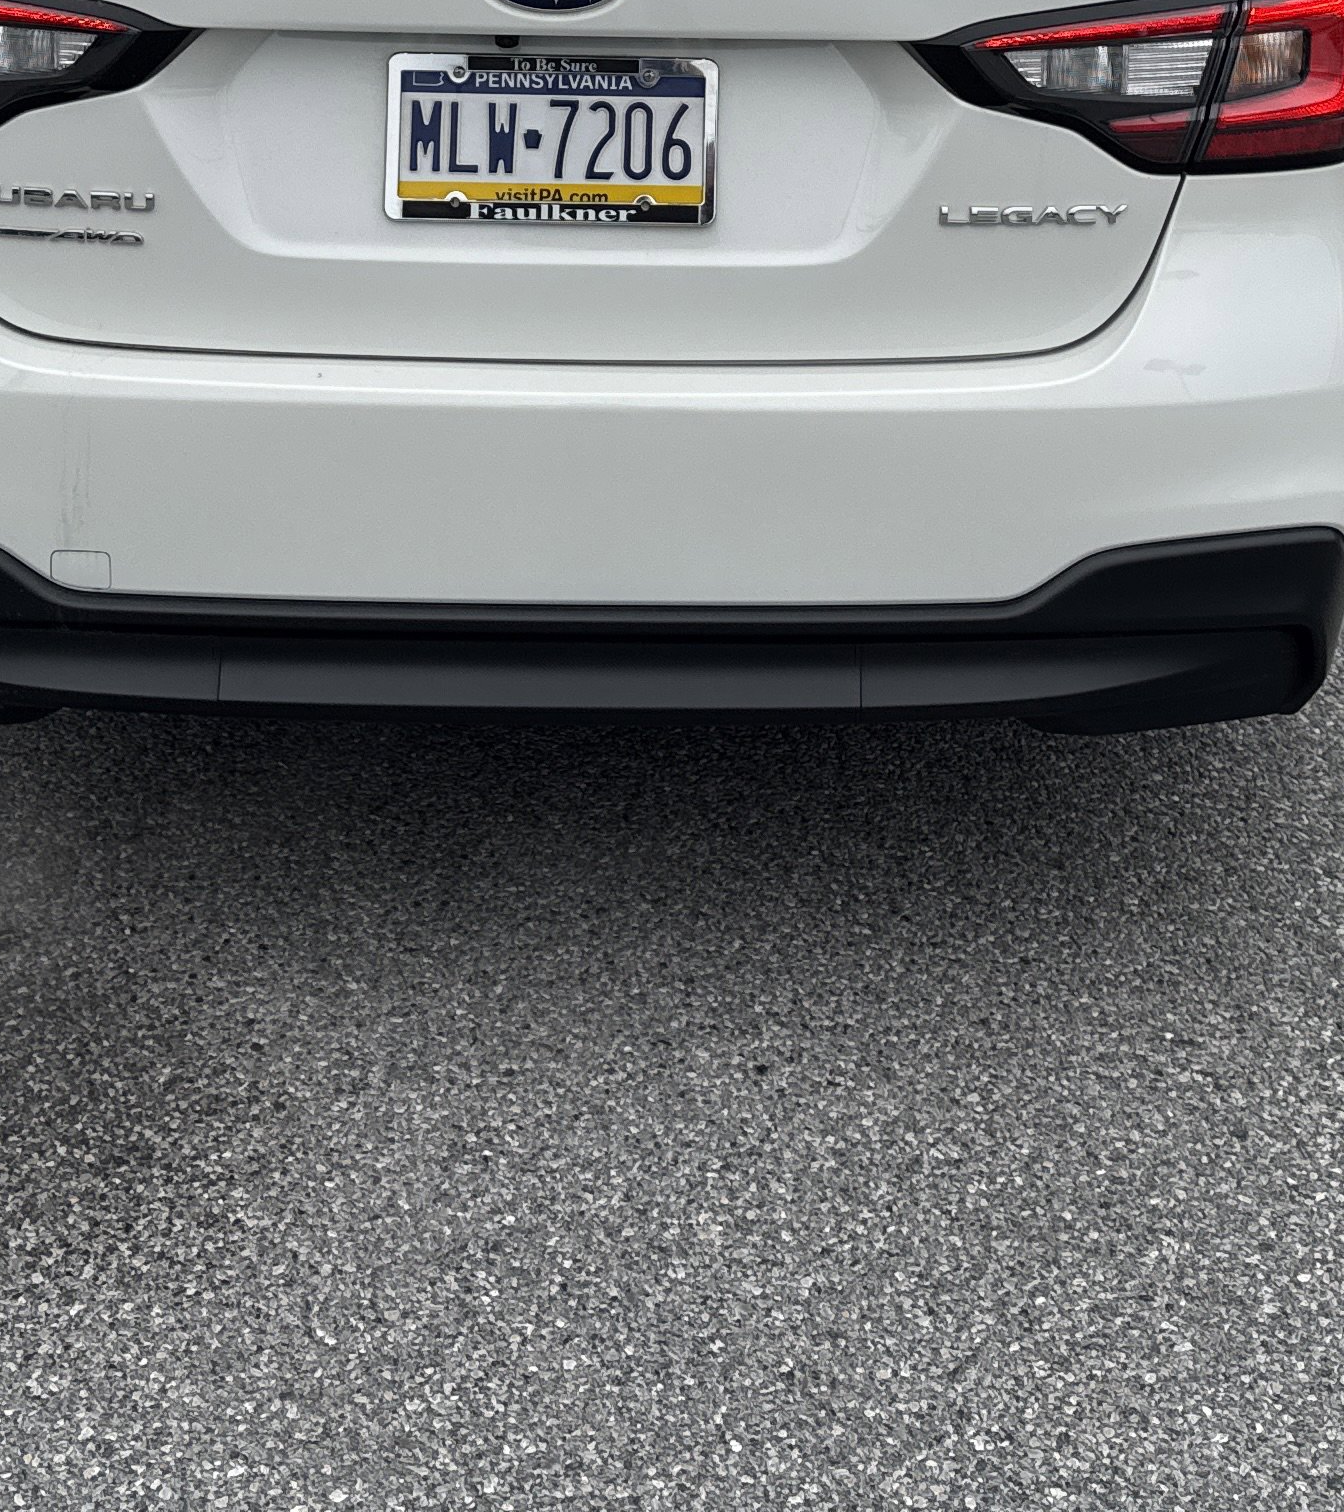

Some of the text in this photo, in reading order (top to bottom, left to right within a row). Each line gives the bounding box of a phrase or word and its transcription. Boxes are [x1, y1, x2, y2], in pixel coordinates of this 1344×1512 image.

[511, 58, 599, 73] To Be Sure
[475, 72, 633, 91] PENNSYLVANIA
[494, 187, 610, 203] visitPAcom
[468, 203, 637, 223] Faulkner
[938, 204, 1129, 226] LEGACY
